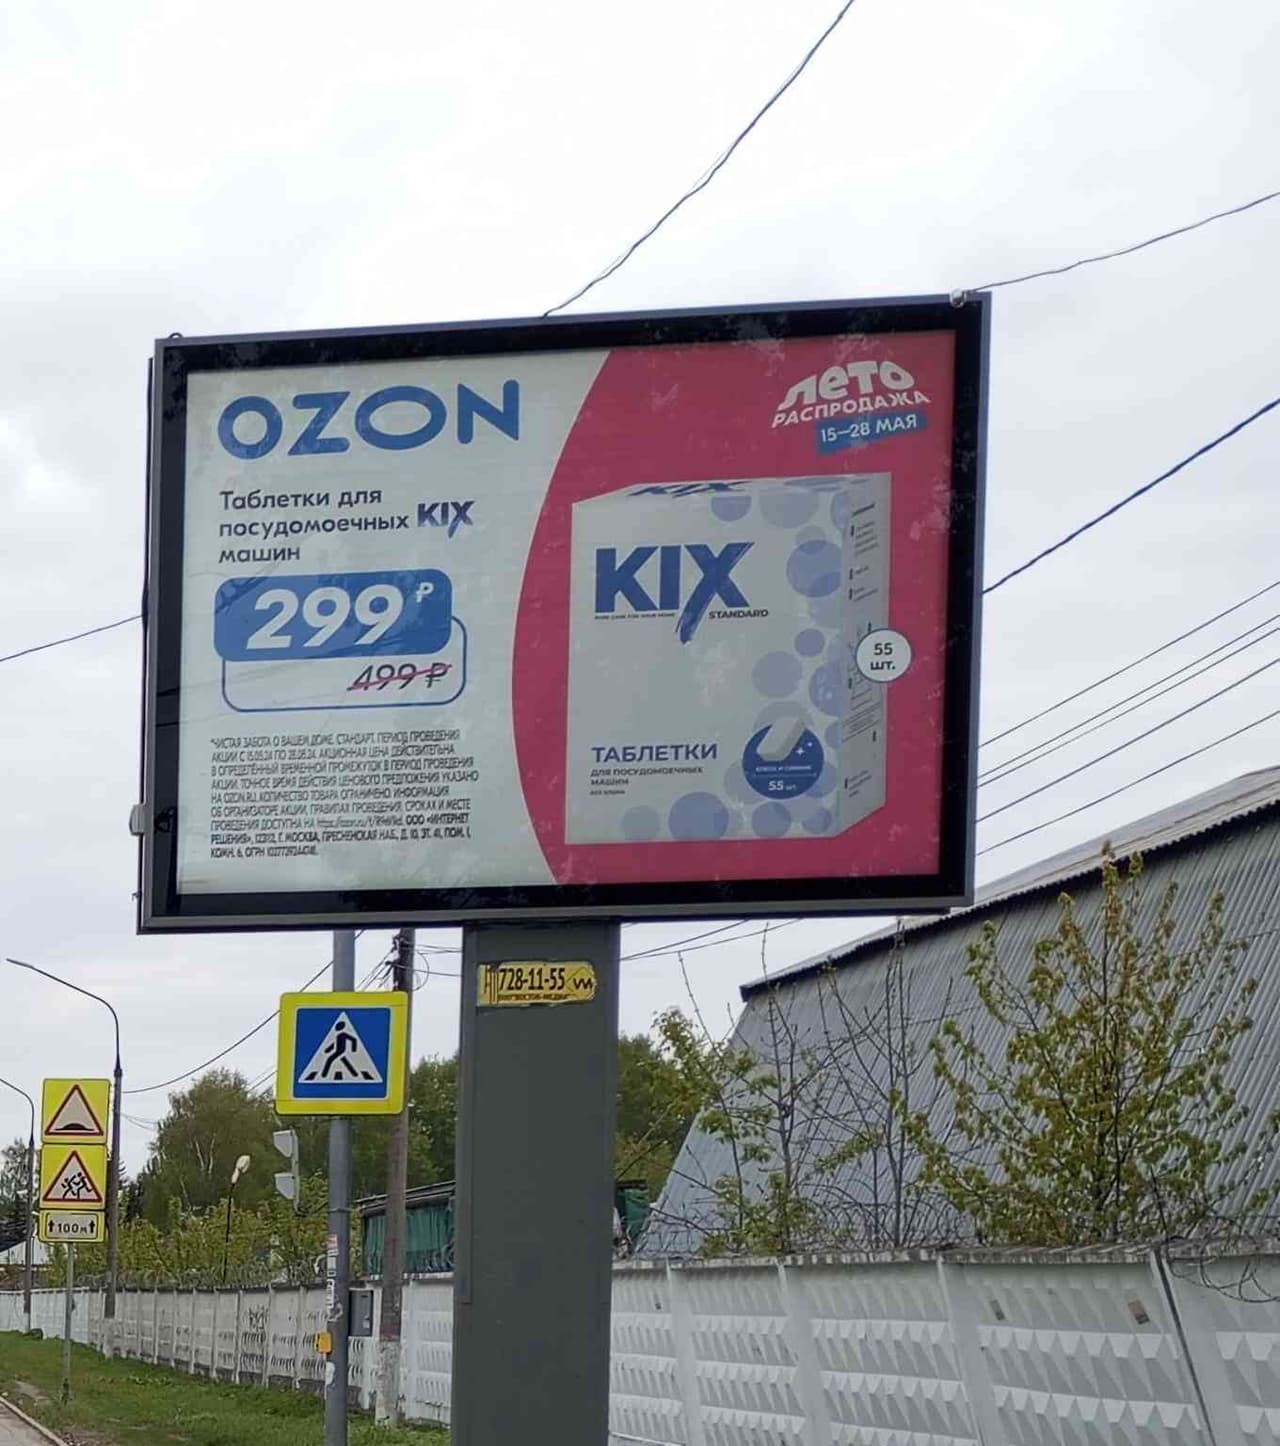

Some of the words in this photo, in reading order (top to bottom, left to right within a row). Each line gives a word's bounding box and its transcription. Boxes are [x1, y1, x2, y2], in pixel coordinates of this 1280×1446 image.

[217, 379, 520, 460] OZON
[771, 390, 931, 429] РАСПРОДАЖА
[876, 414, 917, 433] МАЯ
[219, 490, 330, 511] Таблетки
[337, 490, 383, 507] для
[219, 513, 410, 540] посудомоечных
[417, 501, 475, 539] KIX
[219, 547, 301, 564] машин
[595, 542, 756, 645] KIX
[246, 584, 404, 650] 299
[708, 609, 769, 619] STANDARD
[874, 643, 893, 655] 55
[351, 664, 416, 690] 499
[592, 744, 717, 763] ТАБЛЕТКИ
[768, 781, 784, 791] 55
[499, 967, 565, 990] 728-11-55
